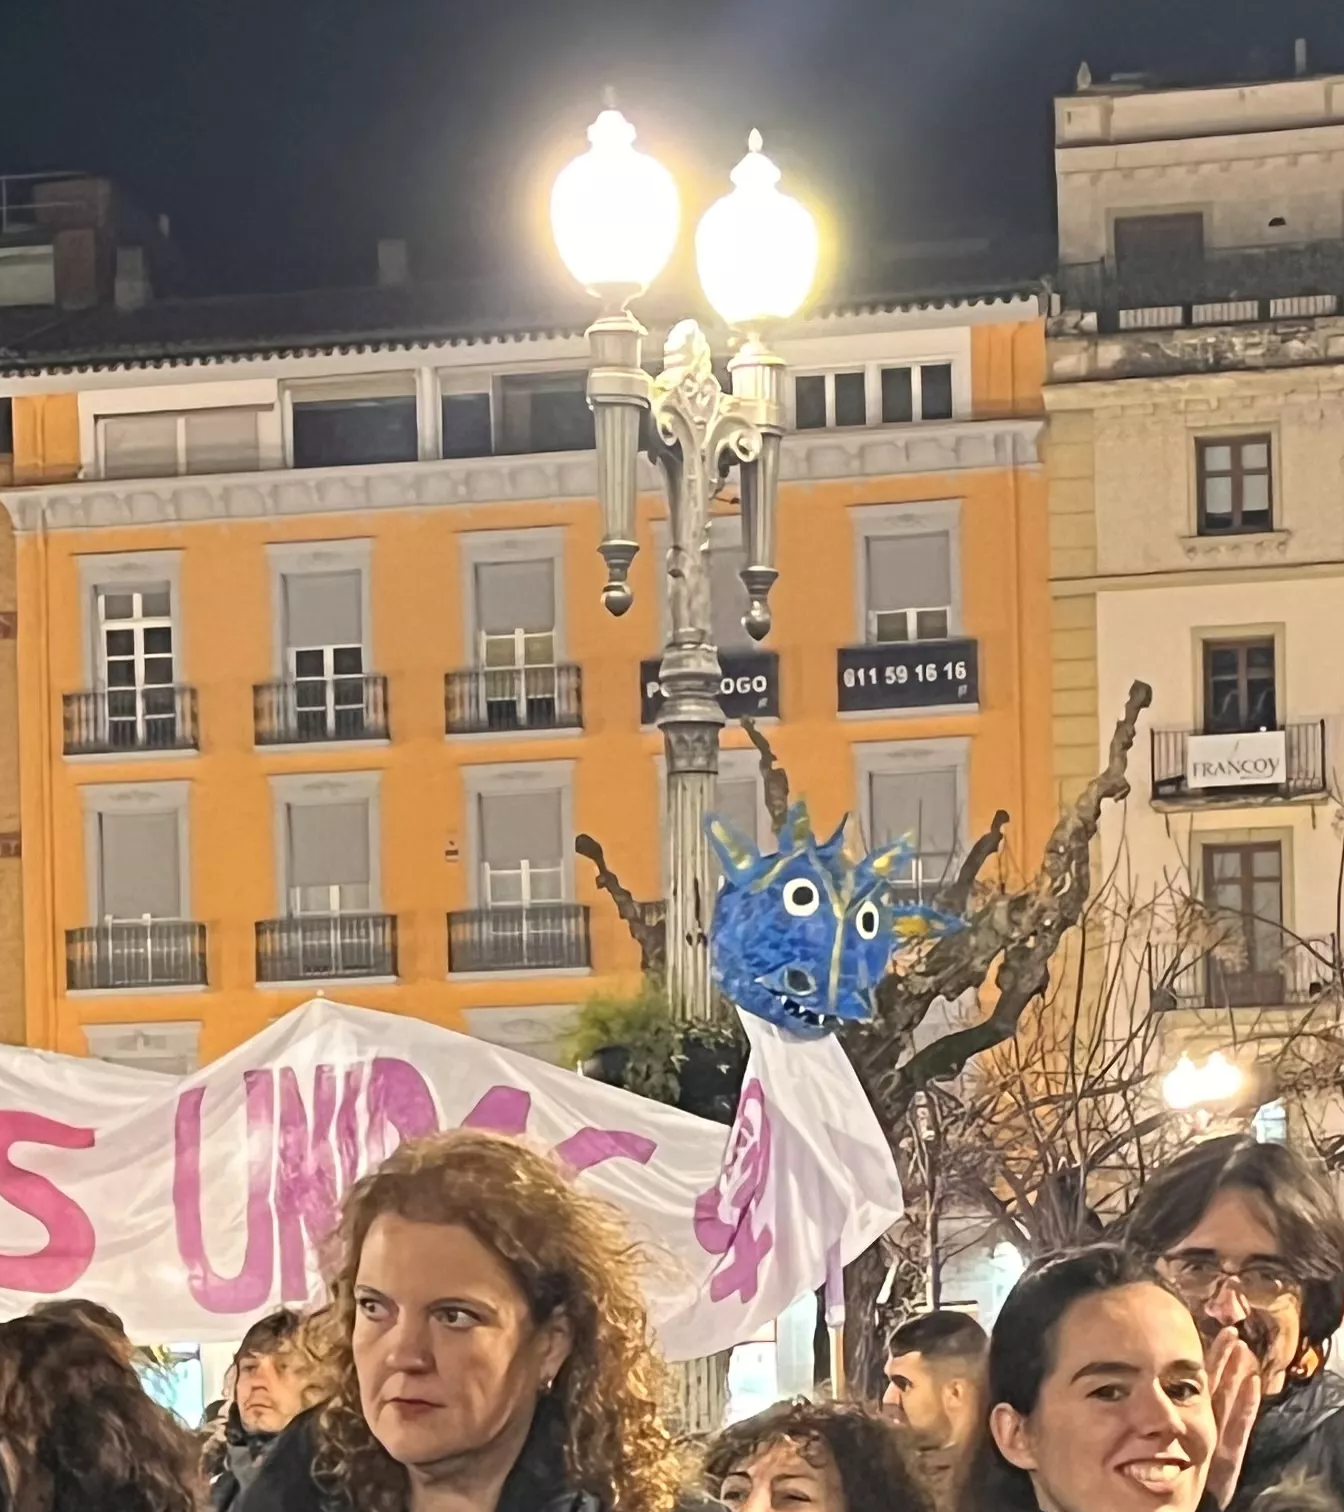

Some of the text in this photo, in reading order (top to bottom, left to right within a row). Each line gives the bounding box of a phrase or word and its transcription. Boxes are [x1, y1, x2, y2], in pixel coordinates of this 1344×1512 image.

[884, 665, 908, 684] 59
[915, 663, 938, 682] 16
[943, 661, 967, 680] 16
[646, 675, 768, 699] POGO
